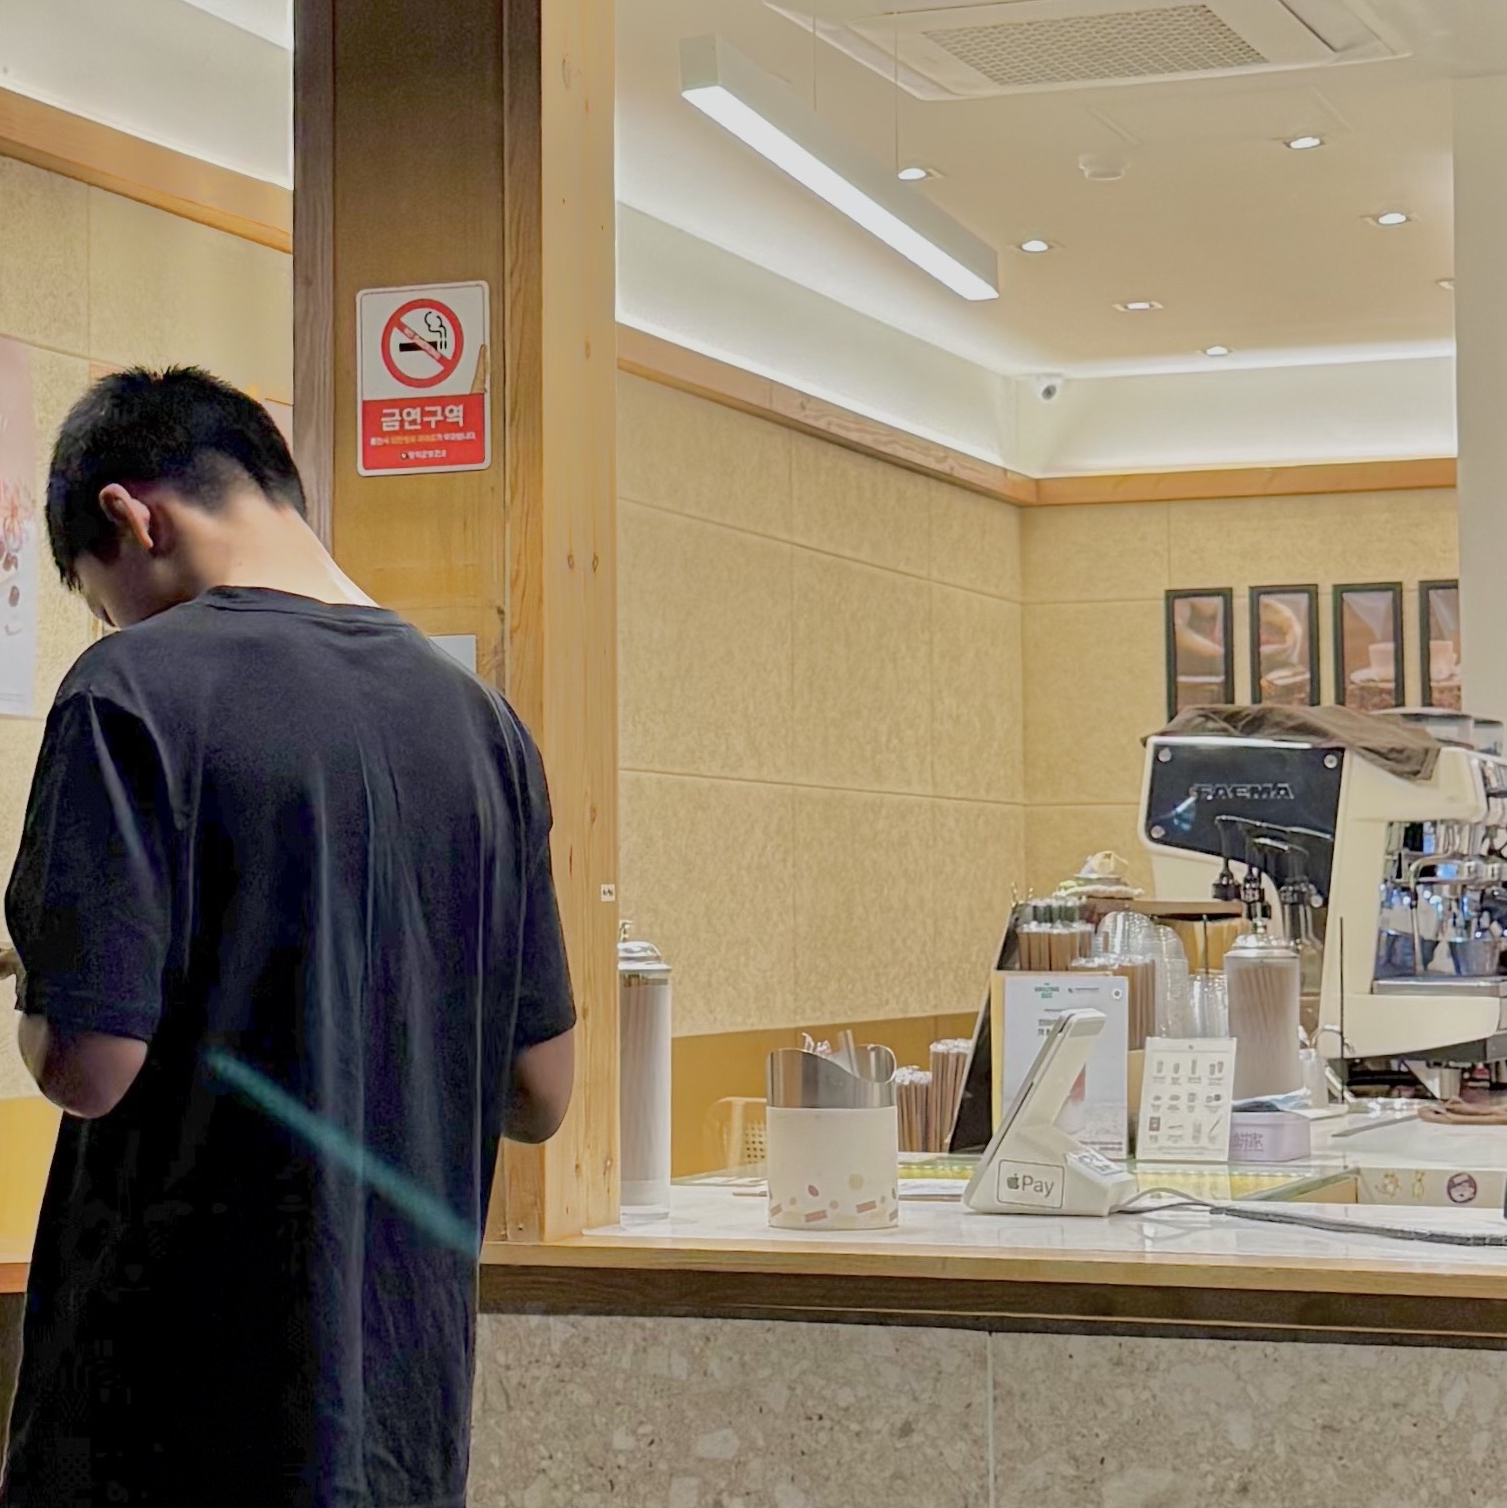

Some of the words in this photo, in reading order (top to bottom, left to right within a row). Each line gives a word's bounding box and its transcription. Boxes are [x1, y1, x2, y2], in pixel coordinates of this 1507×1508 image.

[380, 403, 465, 432] 금연구역
[1195, 782, 1296, 800] FAEMA
[1021, 1175, 1055, 1199] Pay
